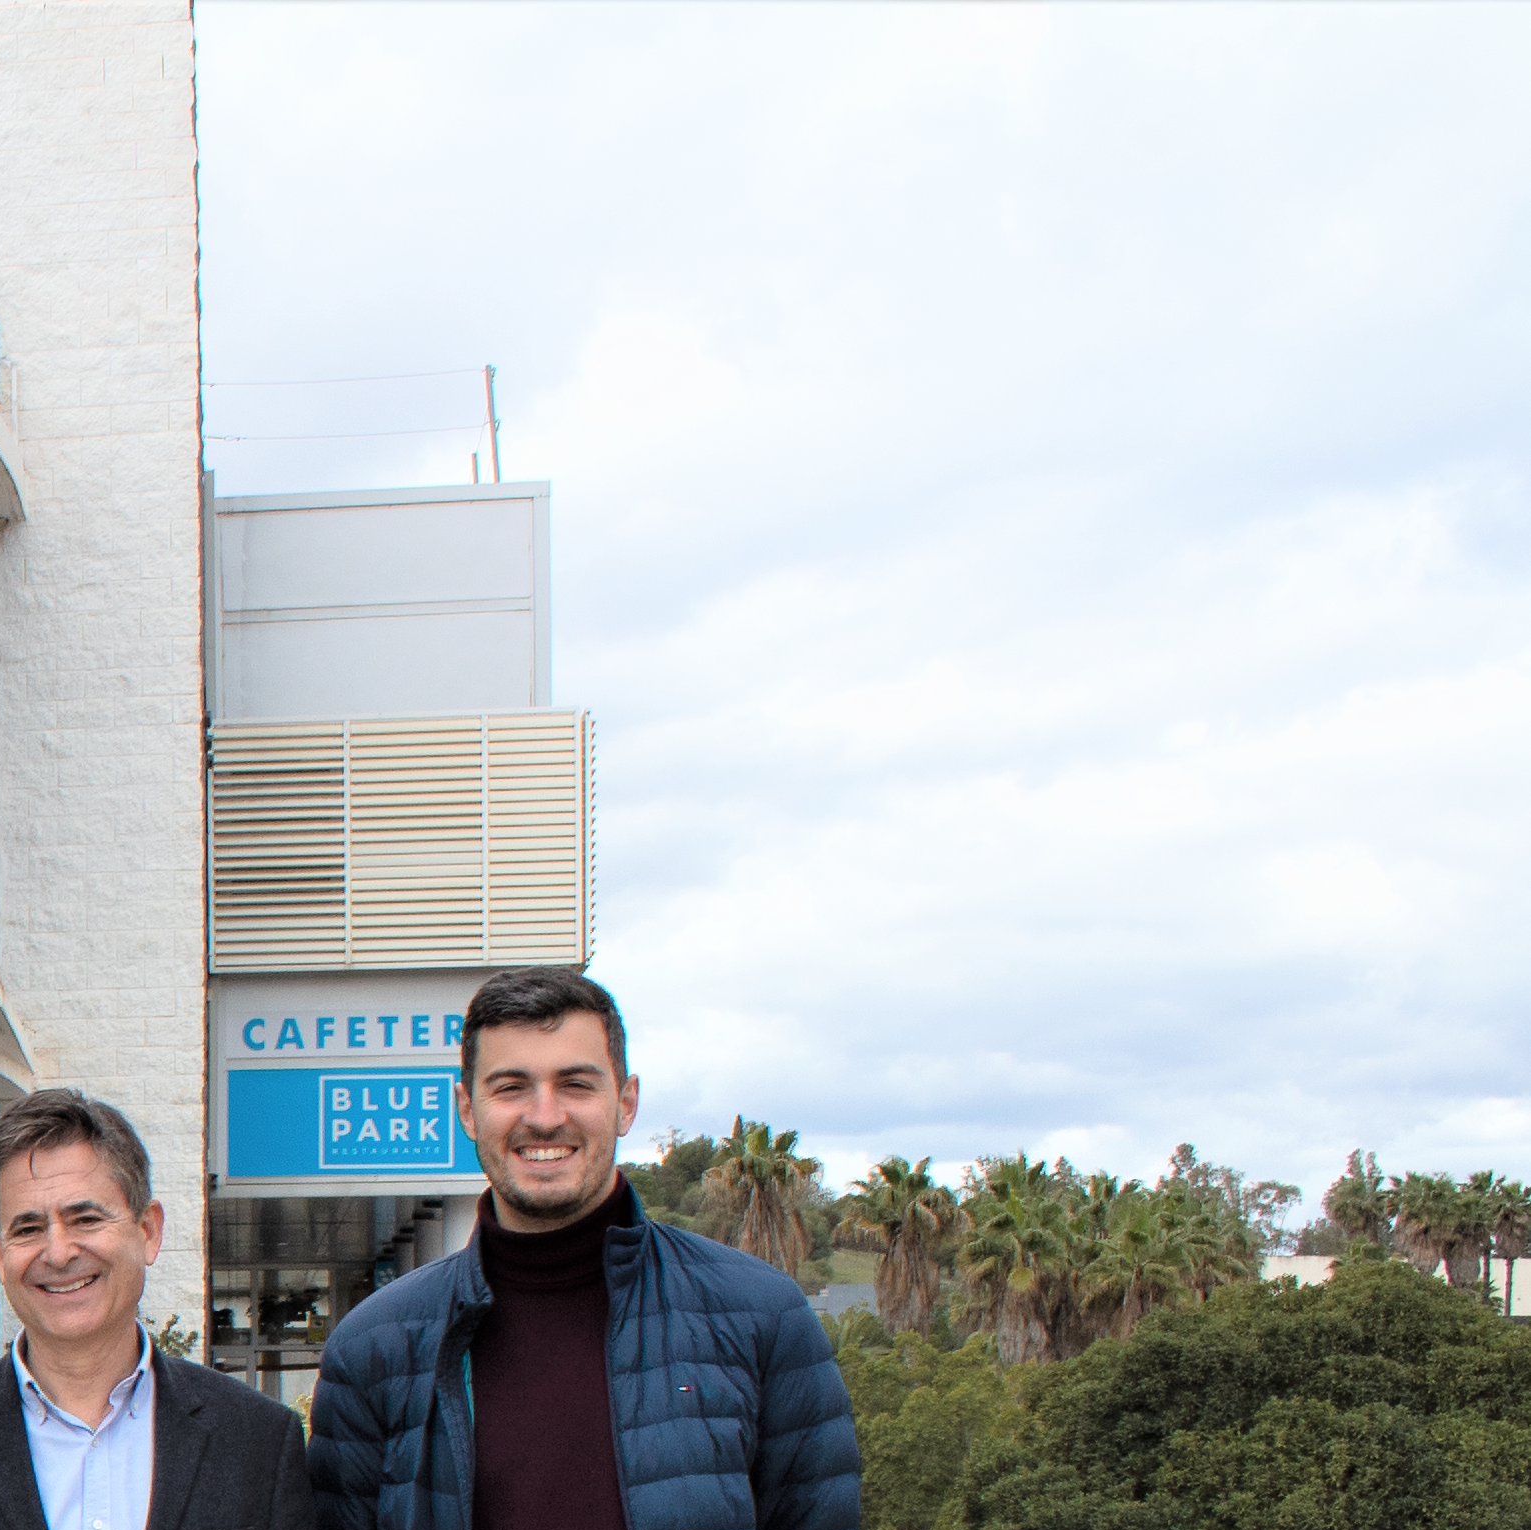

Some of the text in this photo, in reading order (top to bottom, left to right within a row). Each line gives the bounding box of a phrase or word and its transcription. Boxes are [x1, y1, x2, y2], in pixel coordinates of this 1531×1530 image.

[242, 1013, 463, 1051] CAFETER
[331, 1085, 441, 1112] BLUE
[331, 1117, 441, 1142] PARK
